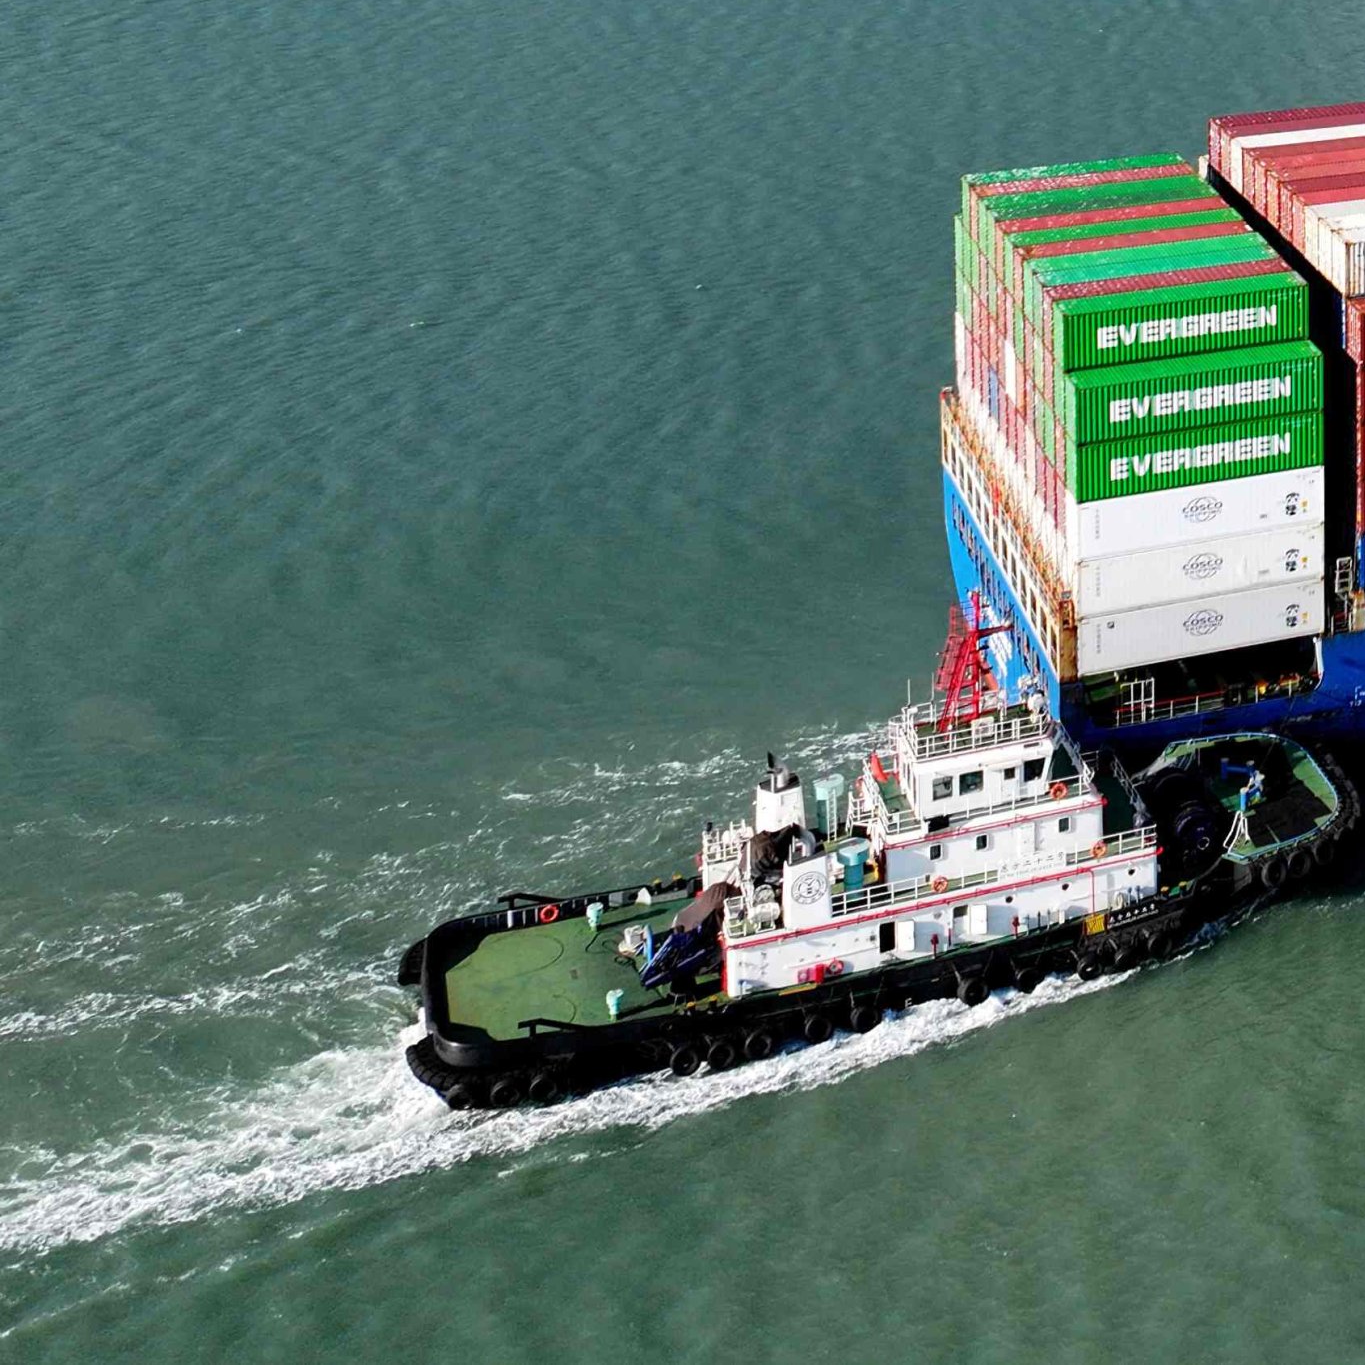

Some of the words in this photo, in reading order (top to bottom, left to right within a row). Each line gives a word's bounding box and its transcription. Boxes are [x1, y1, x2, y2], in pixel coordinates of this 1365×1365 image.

[1097, 304, 1278, 350] EVERGREEN
[1109, 375, 1292, 424] EVERGREEN
[1110, 432, 1291, 482] EVERGREEN
[1182, 501, 1223, 515] COSCO
[1182, 557, 1223, 573] COSCO
[1183, 613, 1223, 629] COSCO
